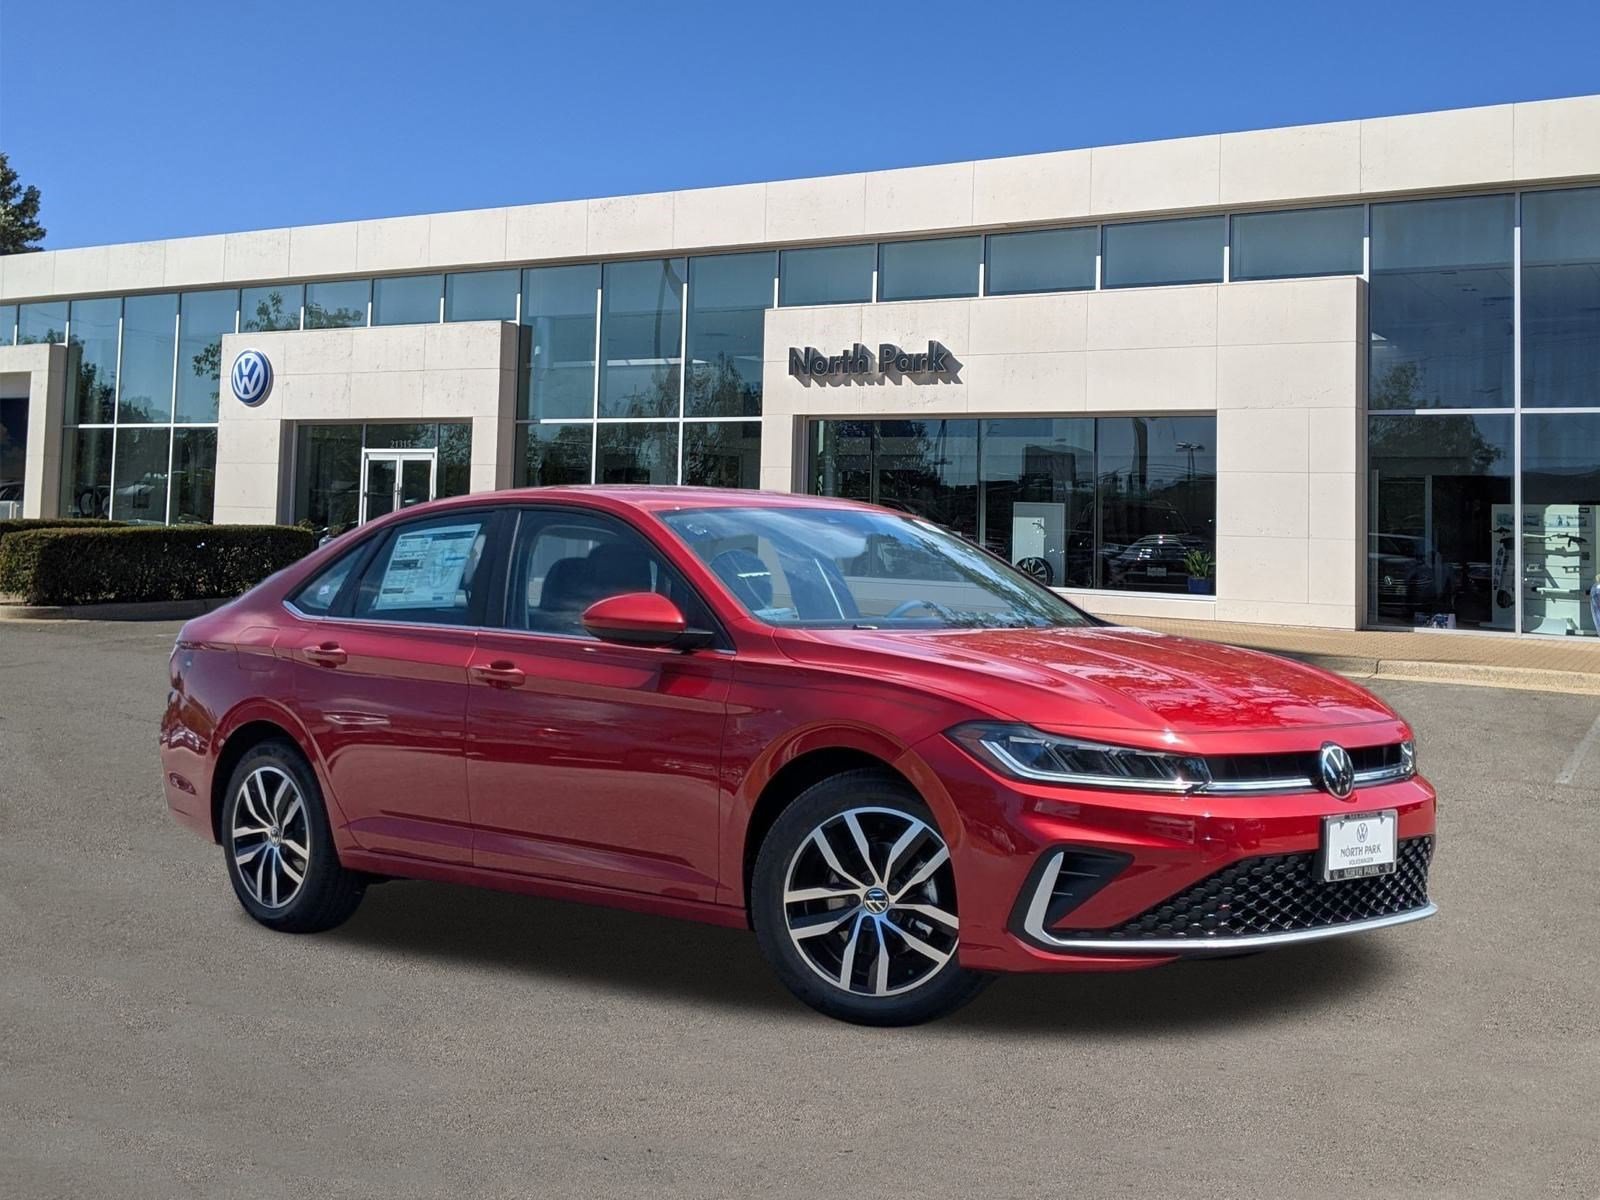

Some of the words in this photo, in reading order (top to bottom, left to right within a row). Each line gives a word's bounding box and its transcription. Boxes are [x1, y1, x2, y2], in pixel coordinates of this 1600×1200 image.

[788, 342, 872, 376] North
[878, 340, 949, 374] Park
[1340, 845, 1364, 858] NORTH
[1364, 843, 1382, 855] PARK
